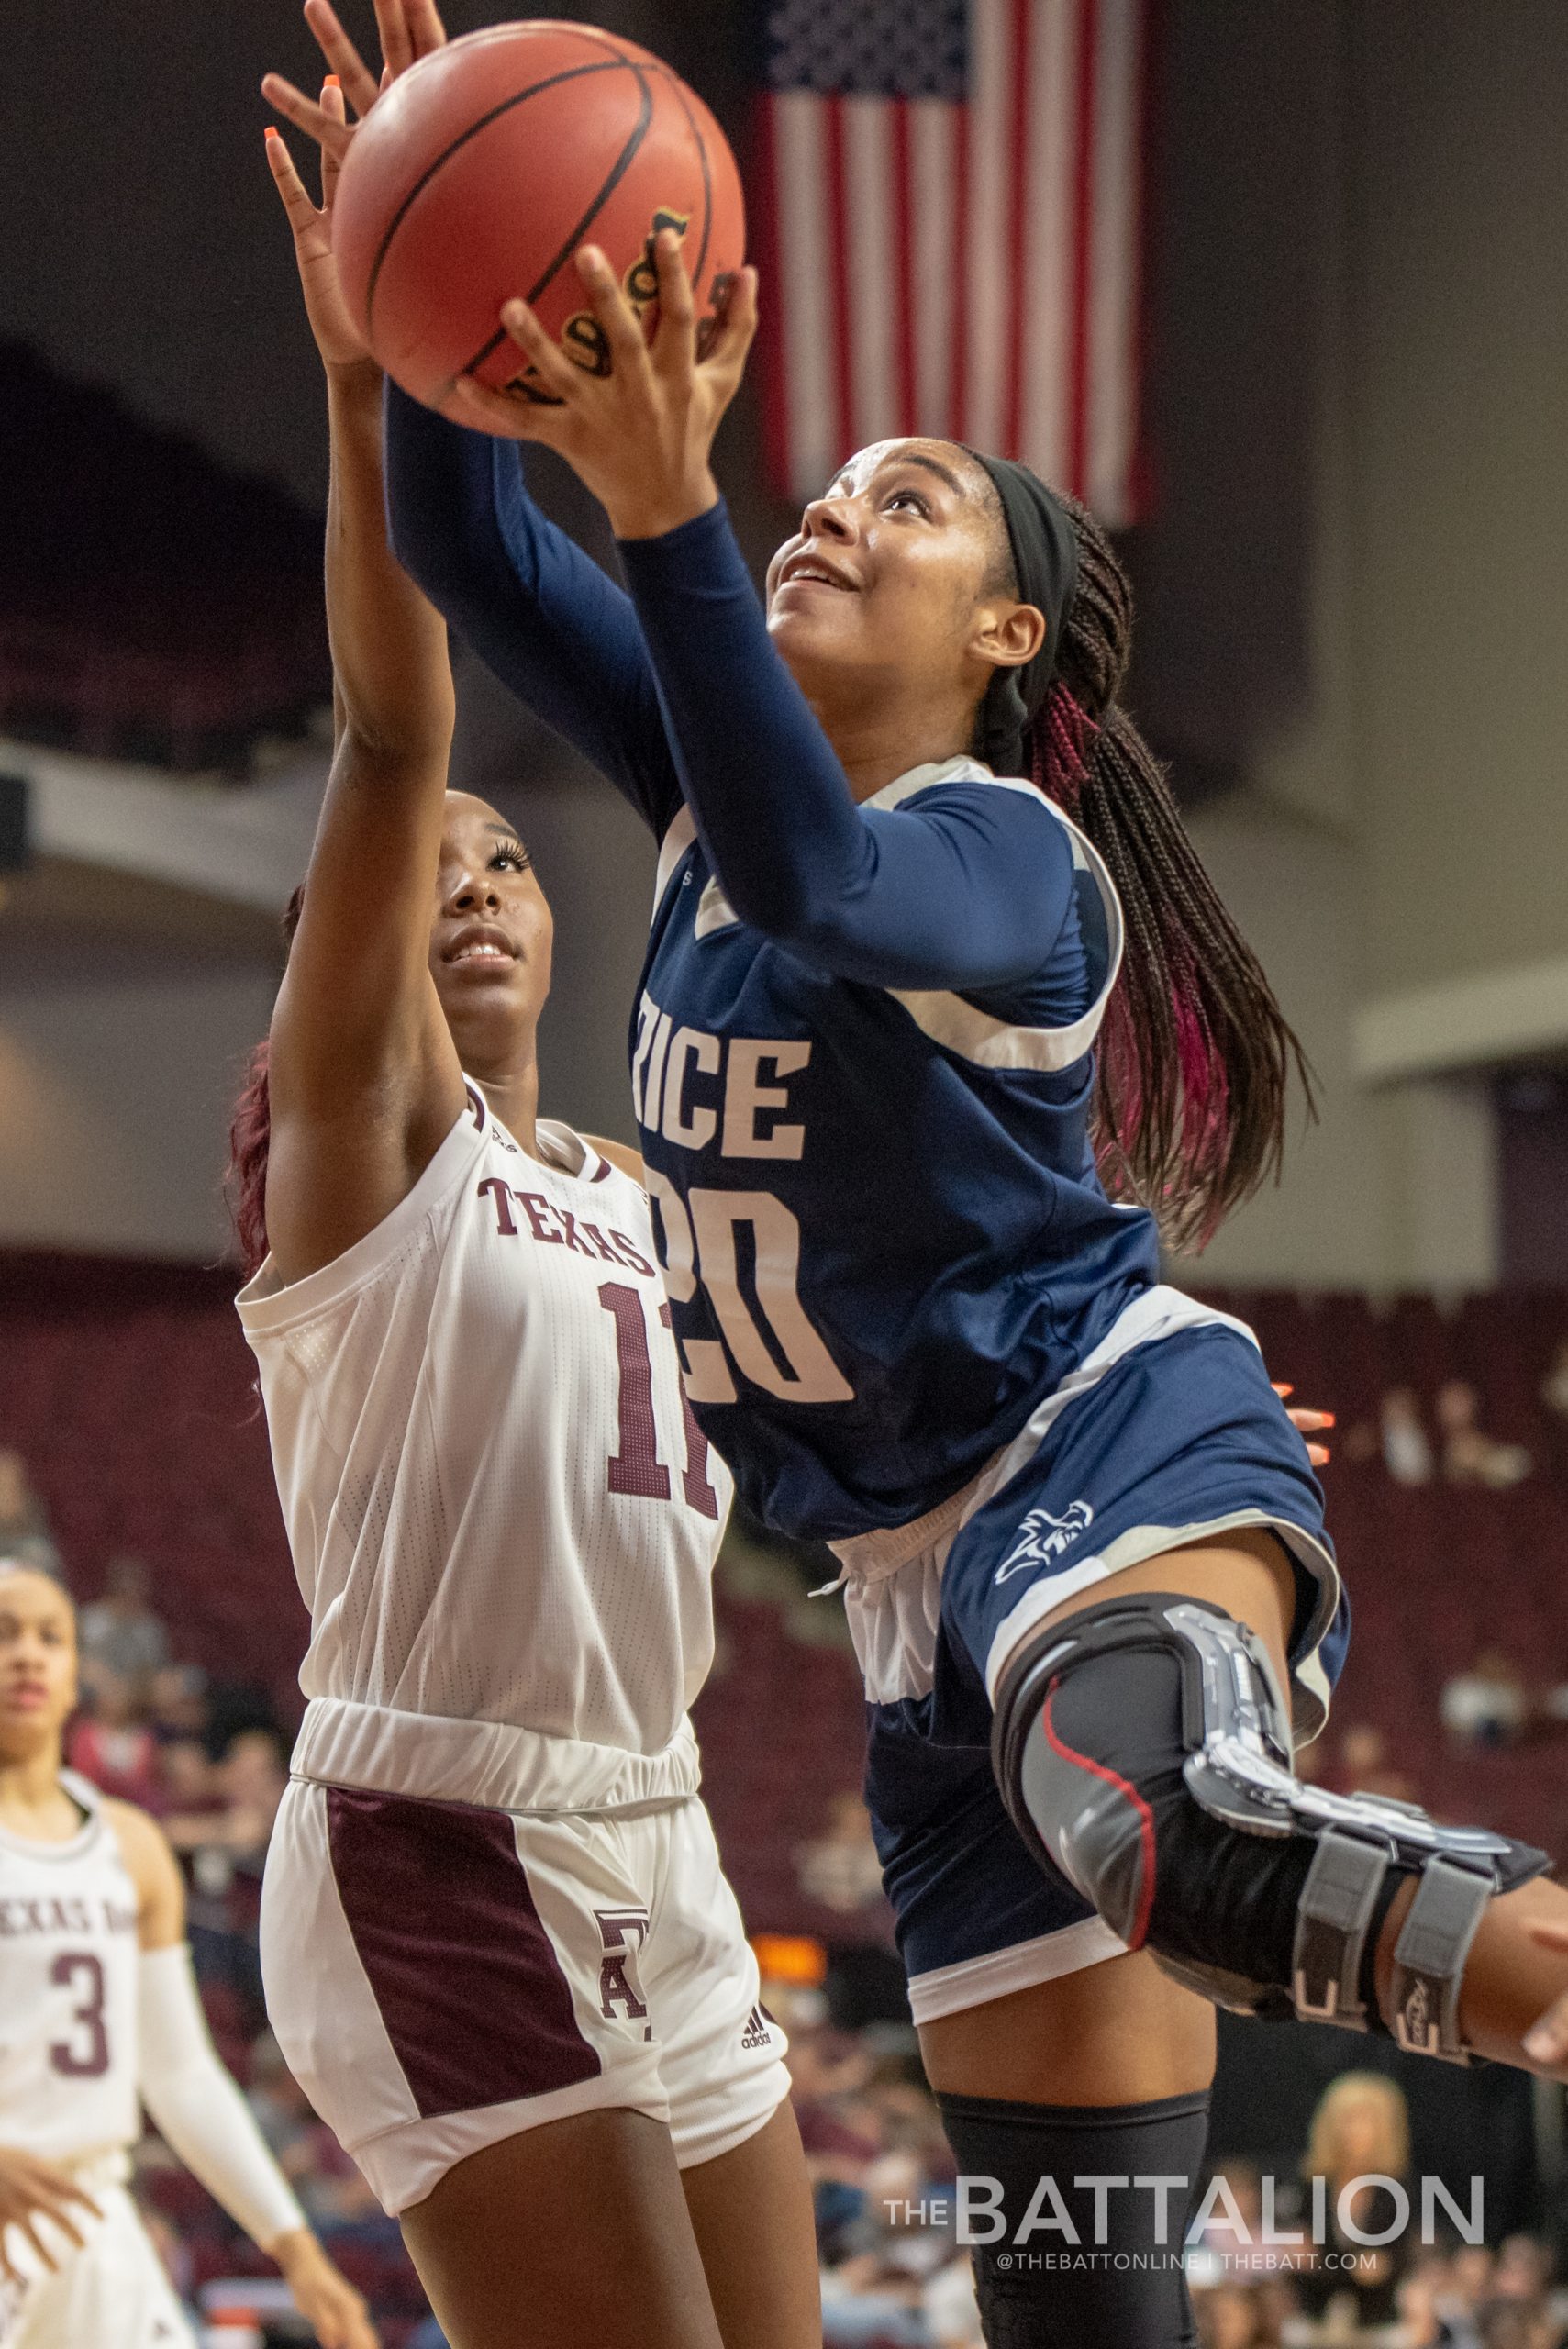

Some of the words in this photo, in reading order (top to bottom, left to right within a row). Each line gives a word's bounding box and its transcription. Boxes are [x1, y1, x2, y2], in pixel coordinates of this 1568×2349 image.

[477, 1177, 656, 1278] TEXAS
[50, 1951, 110, 2077] 3
[741, 2031, 772, 2050] adidas
